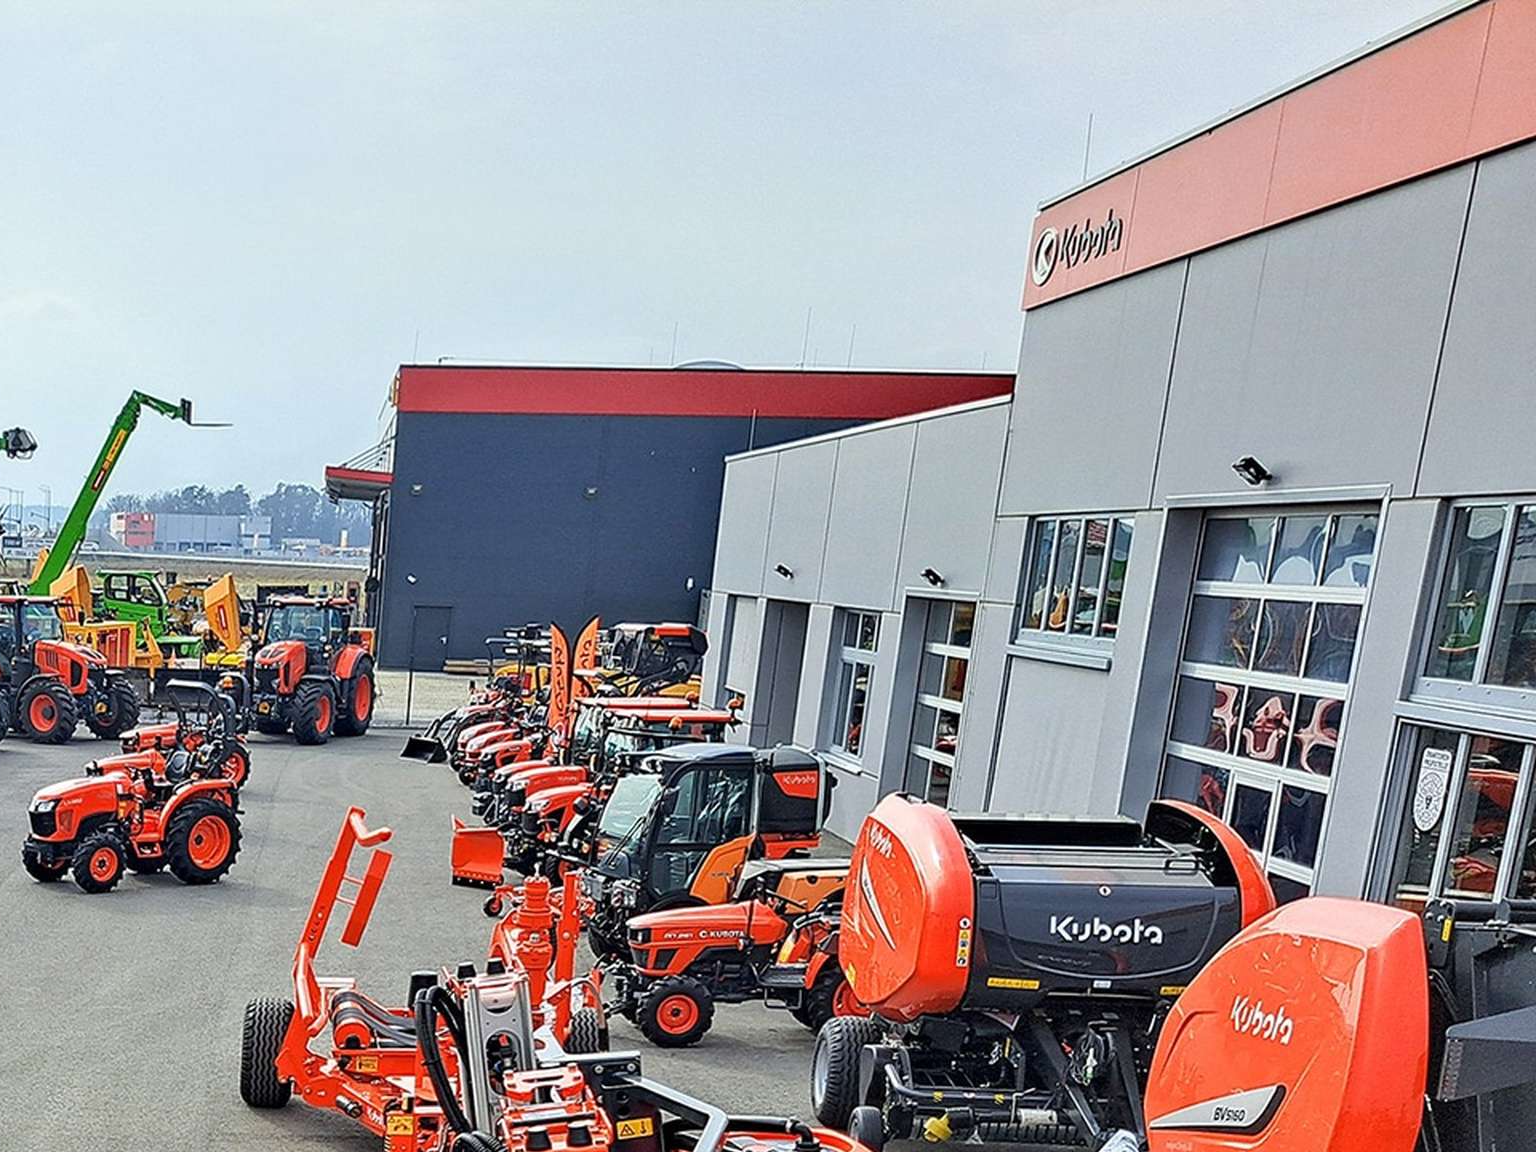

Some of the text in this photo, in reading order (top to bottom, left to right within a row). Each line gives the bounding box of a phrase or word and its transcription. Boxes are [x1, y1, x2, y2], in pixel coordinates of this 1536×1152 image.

[1060, 208, 1123, 269] Kubota
[711, 930, 746, 938] KUBOTA
[1050, 915, 1163, 944] Kubota
[1231, 995, 1294, 1045] Kubota
